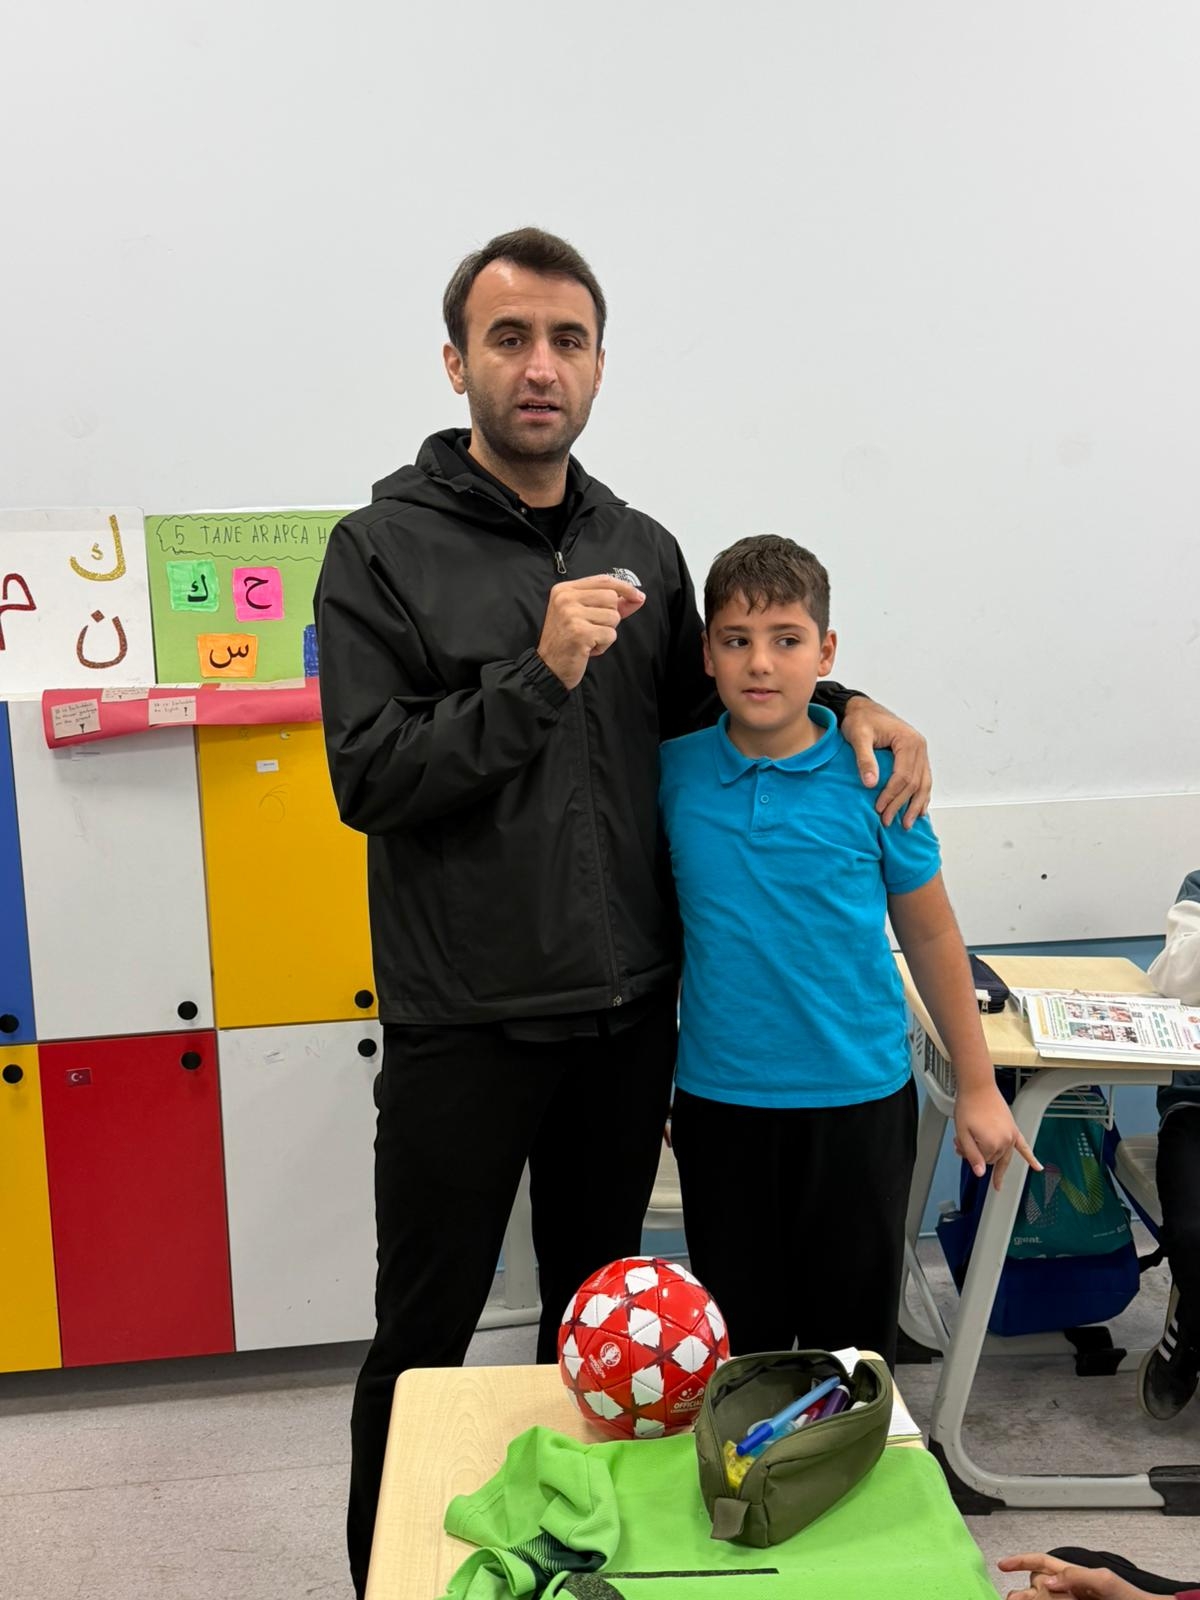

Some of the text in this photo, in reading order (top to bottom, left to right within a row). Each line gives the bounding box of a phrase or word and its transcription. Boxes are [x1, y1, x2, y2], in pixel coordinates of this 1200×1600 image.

[70, 514, 127, 582] ك
[174, 524, 185, 546] 5
[200, 525, 243, 545] TANE
[252, 524, 309, 545] ARAPÇA
[187, 573, 209, 603] ك
[243, 576, 273, 610] ح
[76, 609, 128, 669] ن
[209, 643, 249, 669] س
